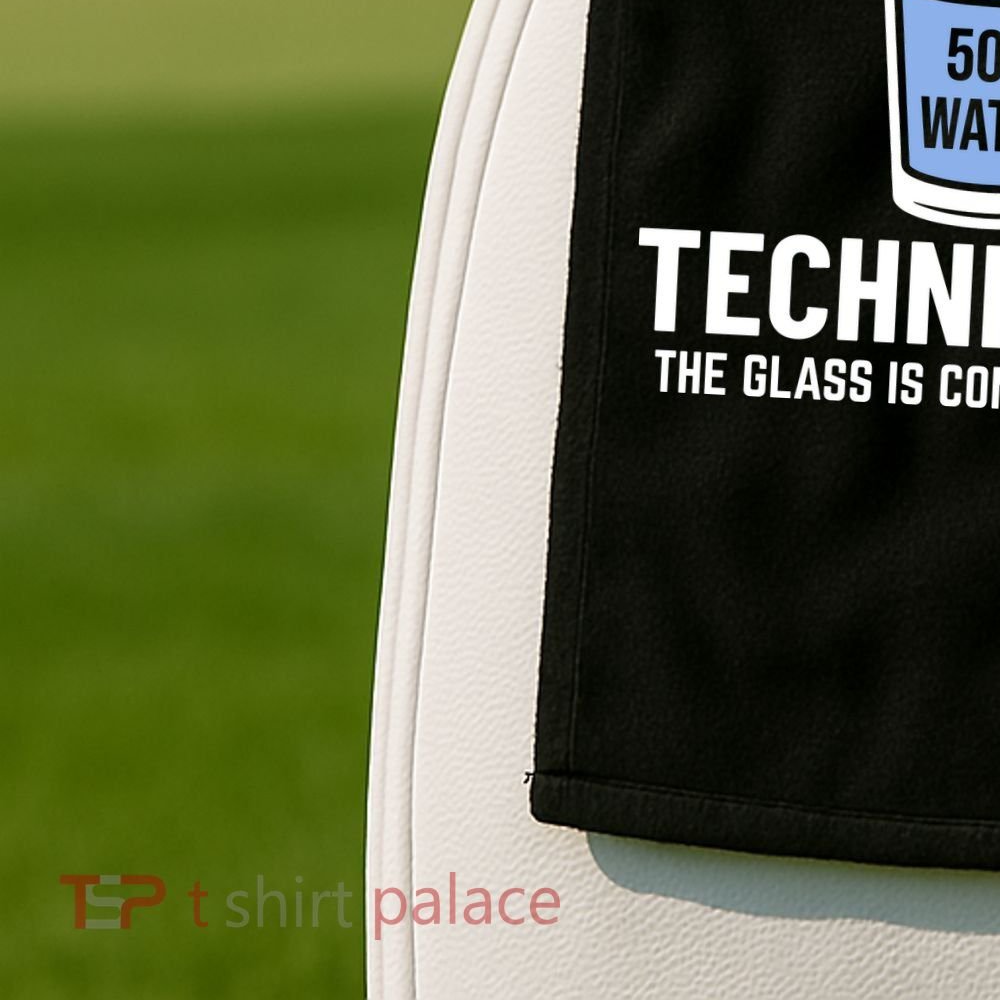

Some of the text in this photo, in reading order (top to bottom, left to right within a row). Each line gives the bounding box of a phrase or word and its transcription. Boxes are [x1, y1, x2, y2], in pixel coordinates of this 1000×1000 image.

[655, 349, 728, 396] THE
[742, 354, 873, 405] GLASS
[887, 361, 924, 406] IS
